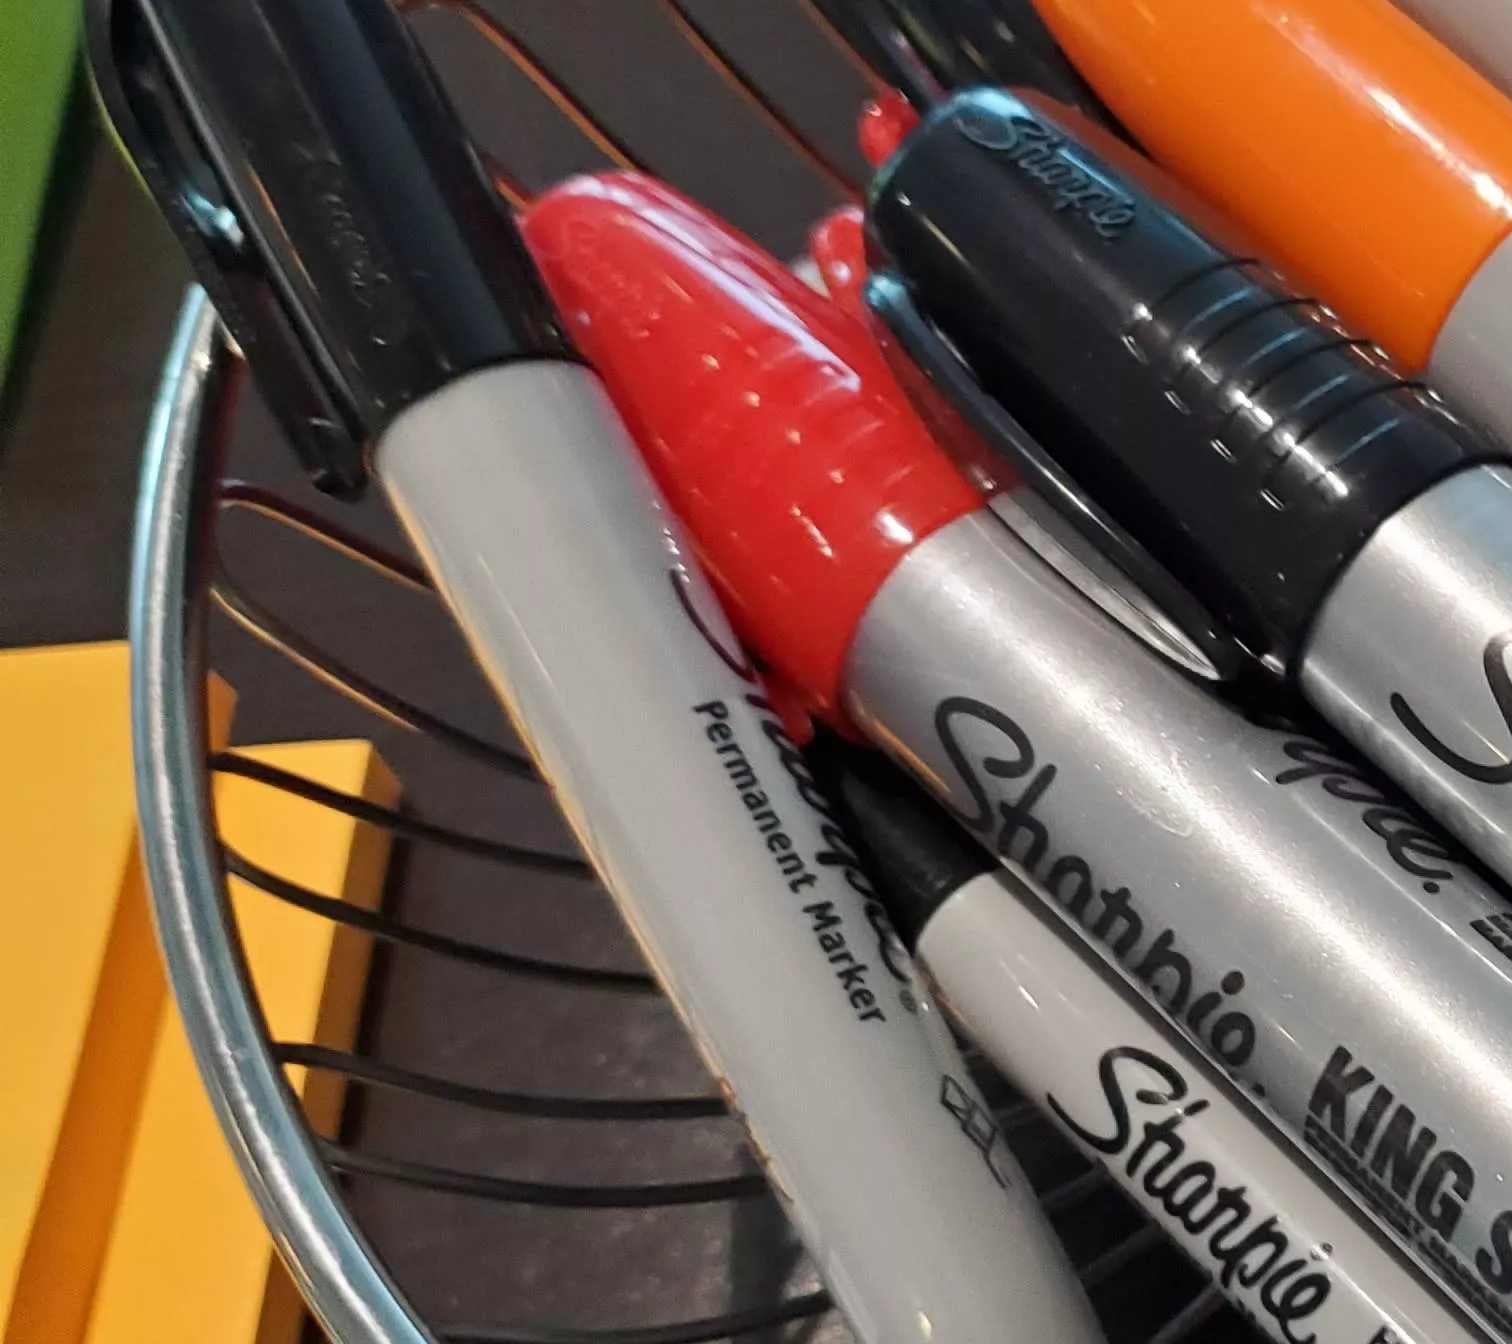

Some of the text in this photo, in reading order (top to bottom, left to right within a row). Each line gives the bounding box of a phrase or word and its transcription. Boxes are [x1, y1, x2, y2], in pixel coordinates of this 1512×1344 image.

[692, 700, 888, 1025] Permanent Marker
[1307, 1044, 1475, 1244] KING
